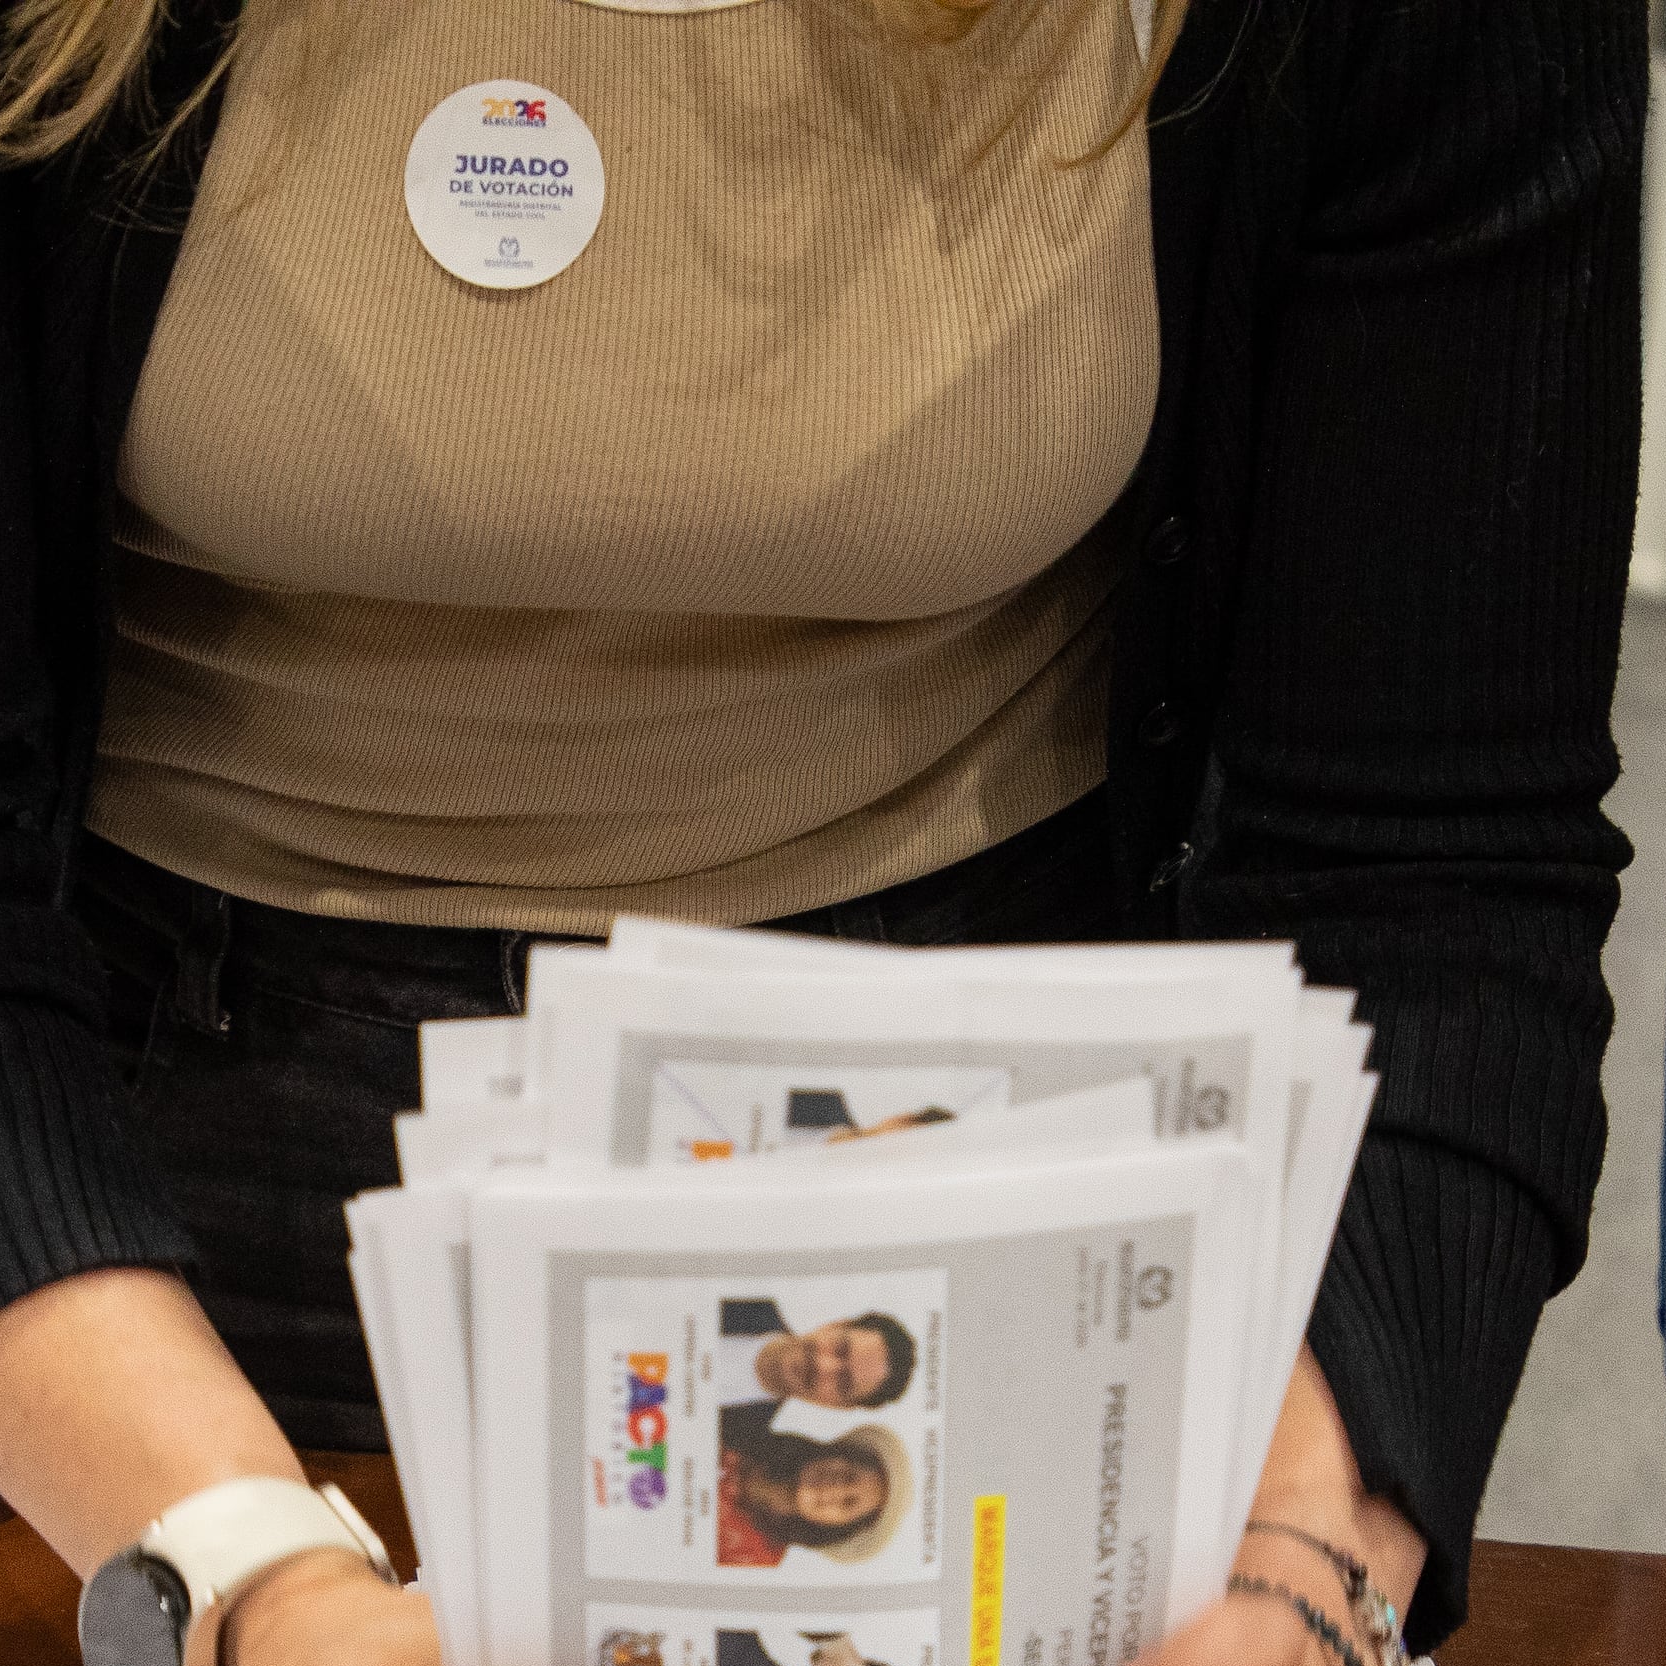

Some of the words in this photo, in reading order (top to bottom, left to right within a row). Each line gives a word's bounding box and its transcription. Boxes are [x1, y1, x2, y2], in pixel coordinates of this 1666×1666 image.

[449, 180, 473, 194] DE
[479, 179, 574, 197] VOTACIÓN
[454, 154, 569, 178] JURADO
[1093, 1384, 1129, 1565] PRESIDENCIA
[978, 1506, 1000, 1596] MARQUE
[1124, 1537, 1150, 1604] VOTO
[1096, 1569, 1117, 1587] Y
[976, 1604, 998, 1652] UNA
[1120, 1611, 1141, 1662] POR
